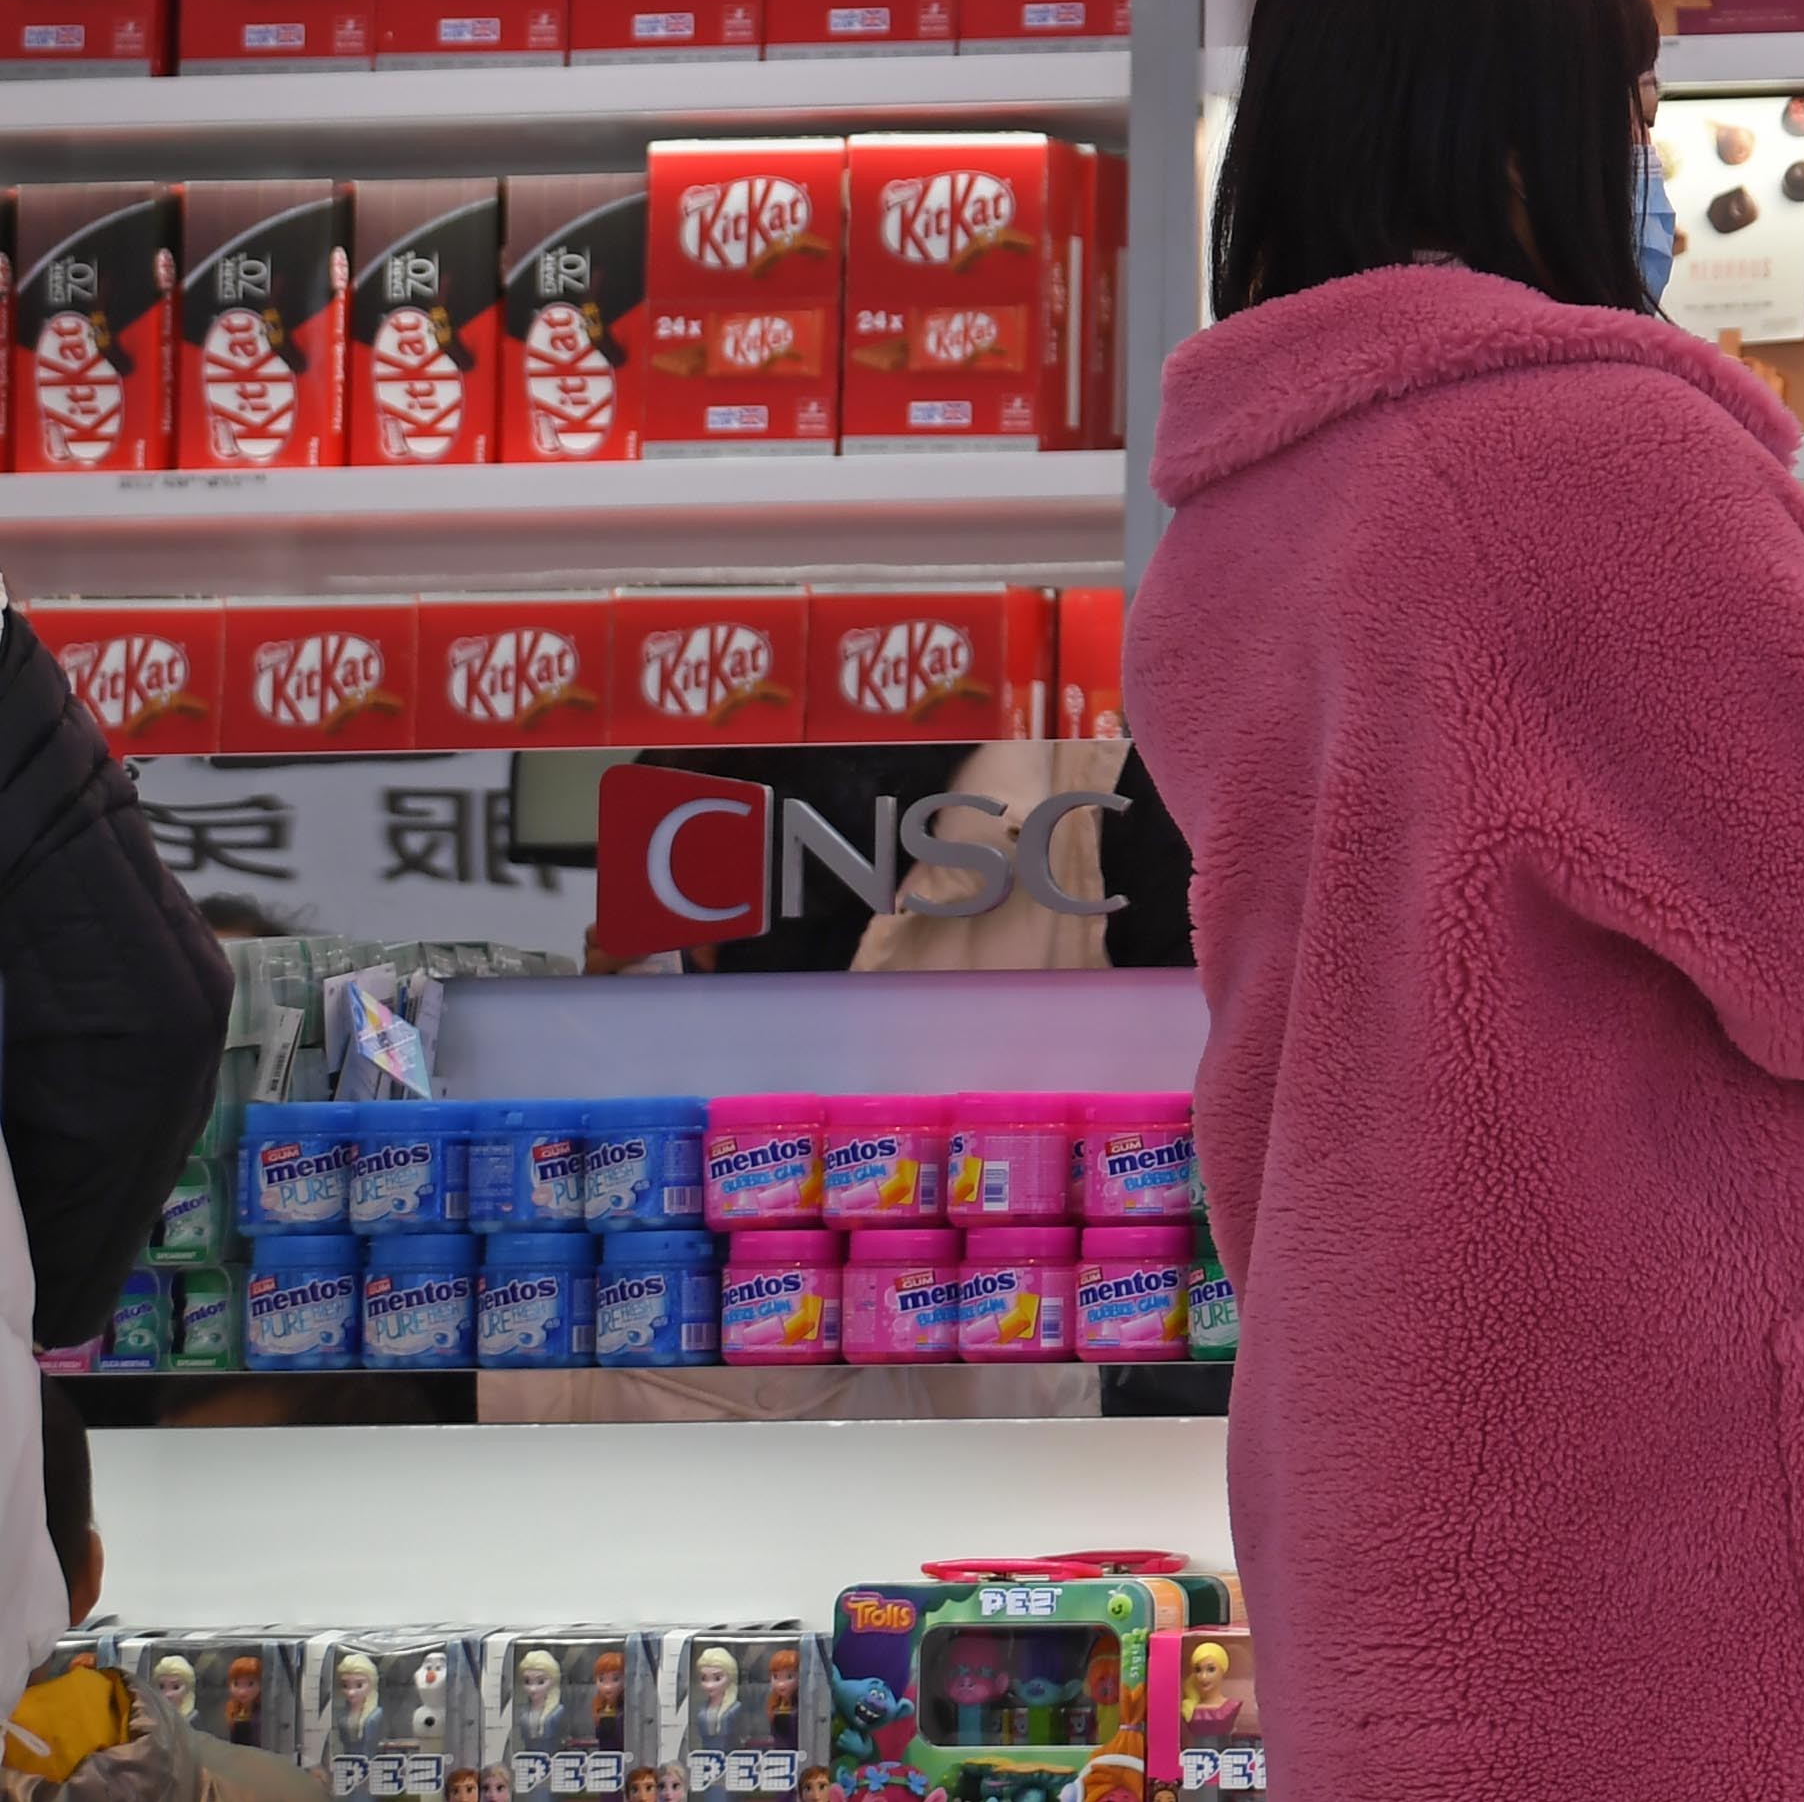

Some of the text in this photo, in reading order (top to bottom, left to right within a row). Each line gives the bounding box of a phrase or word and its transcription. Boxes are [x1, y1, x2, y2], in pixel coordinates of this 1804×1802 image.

[700, 178, 804, 267] KitKat
[899, 172, 1005, 262] KitKat
[1689, 258, 1771, 280] NEUHAUS
[38, 311, 120, 444] KitKat
[206, 310, 292, 438] KitKat
[376, 308, 462, 436] KitKat
[528, 305, 614, 435] KitKat
[74, 636, 184, 726] KitKat
[270, 633, 379, 724] KitKat
[465, 630, 574, 720] KitKat
[658, 624, 767, 715] KitKat
[857, 621, 966, 712] KitKat
[647, 791, 1133, 921] CNSC
[710, 1136, 813, 1180] mentos
[721, 1162, 805, 1195] BUBBLE GUM
[281, 1177, 334, 1206] PURE
[252, 1275, 353, 1316] mentos
[367, 1277, 468, 1316] mentos
[902, 1273, 934, 1289] GUM
[1079, 1269, 1179, 1309] mentos
[260, 1308, 313, 1341] PURE
[375, 1310, 427, 1341] PURE
[1087, 1296, 1170, 1326] BUBBLE GUM
[1192, 1302, 1237, 1328] PURE
[848, 1601, 912, 1629] Trolls
[979, 1589, 1058, 1616] PEZ
[332, 1755, 445, 1795] PEZ
[511, 1751, 626, 1793] PEZ
[687, 1750, 800, 1792] PEZ
